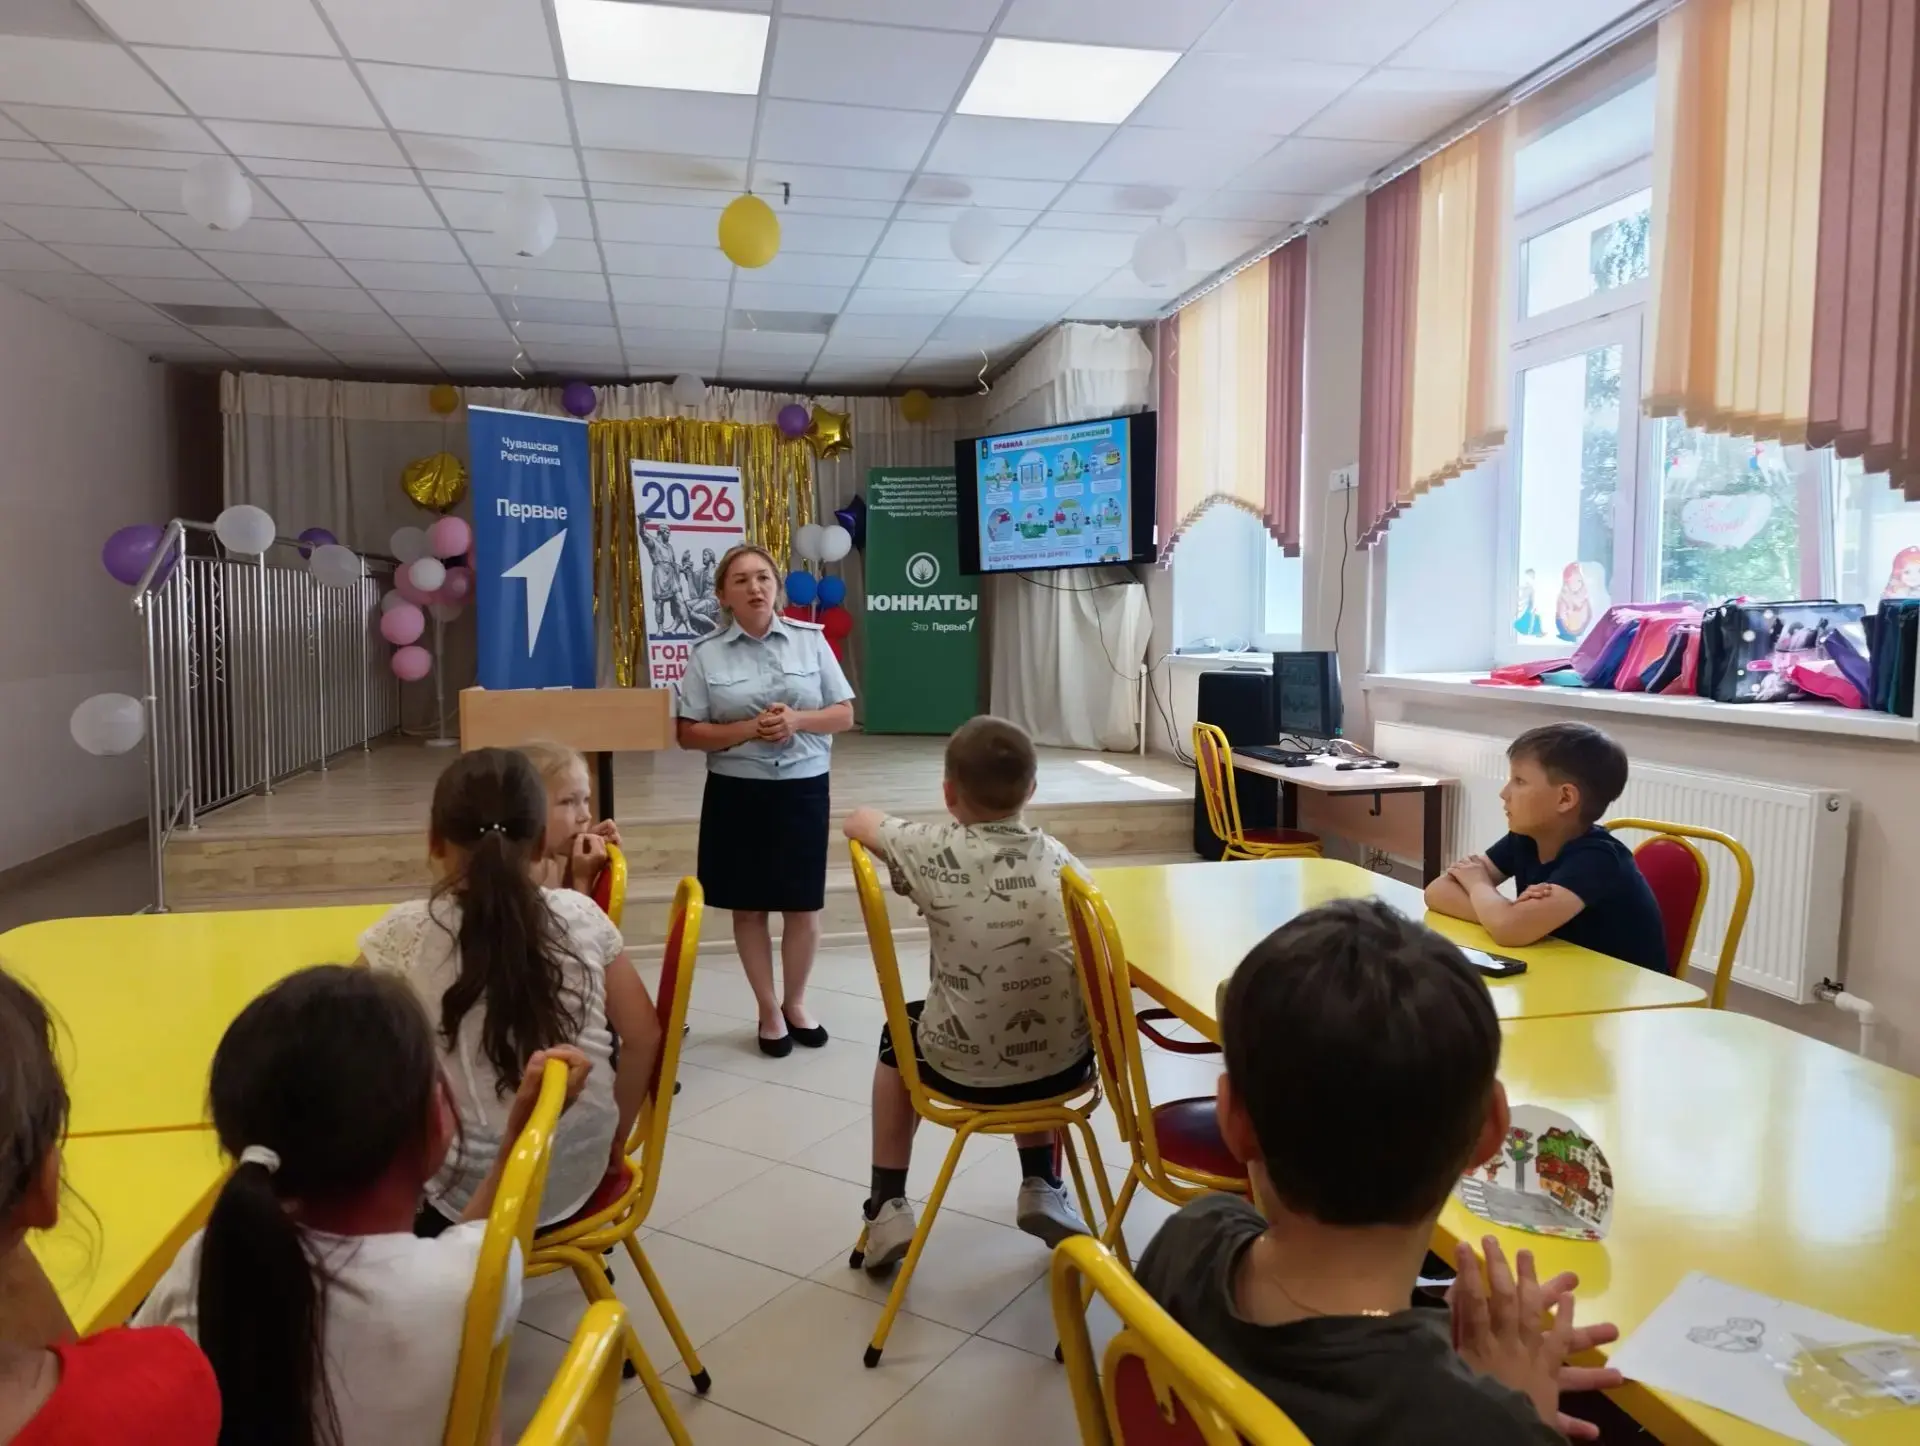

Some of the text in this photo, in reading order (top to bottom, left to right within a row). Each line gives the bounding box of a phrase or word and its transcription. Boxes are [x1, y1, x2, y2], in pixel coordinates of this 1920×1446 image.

[502, 437, 559, 453] Чувашская
[500, 450, 561, 466] Республика
[642, 481, 735, 522] 2026
[496, 498, 568, 523] Первые
[867, 594, 978, 611] ЮННАТЫ
[911, 622, 967, 633] Это Первые
[651, 644, 689, 662] ГОД
[920, 864, 970, 884] adidas
